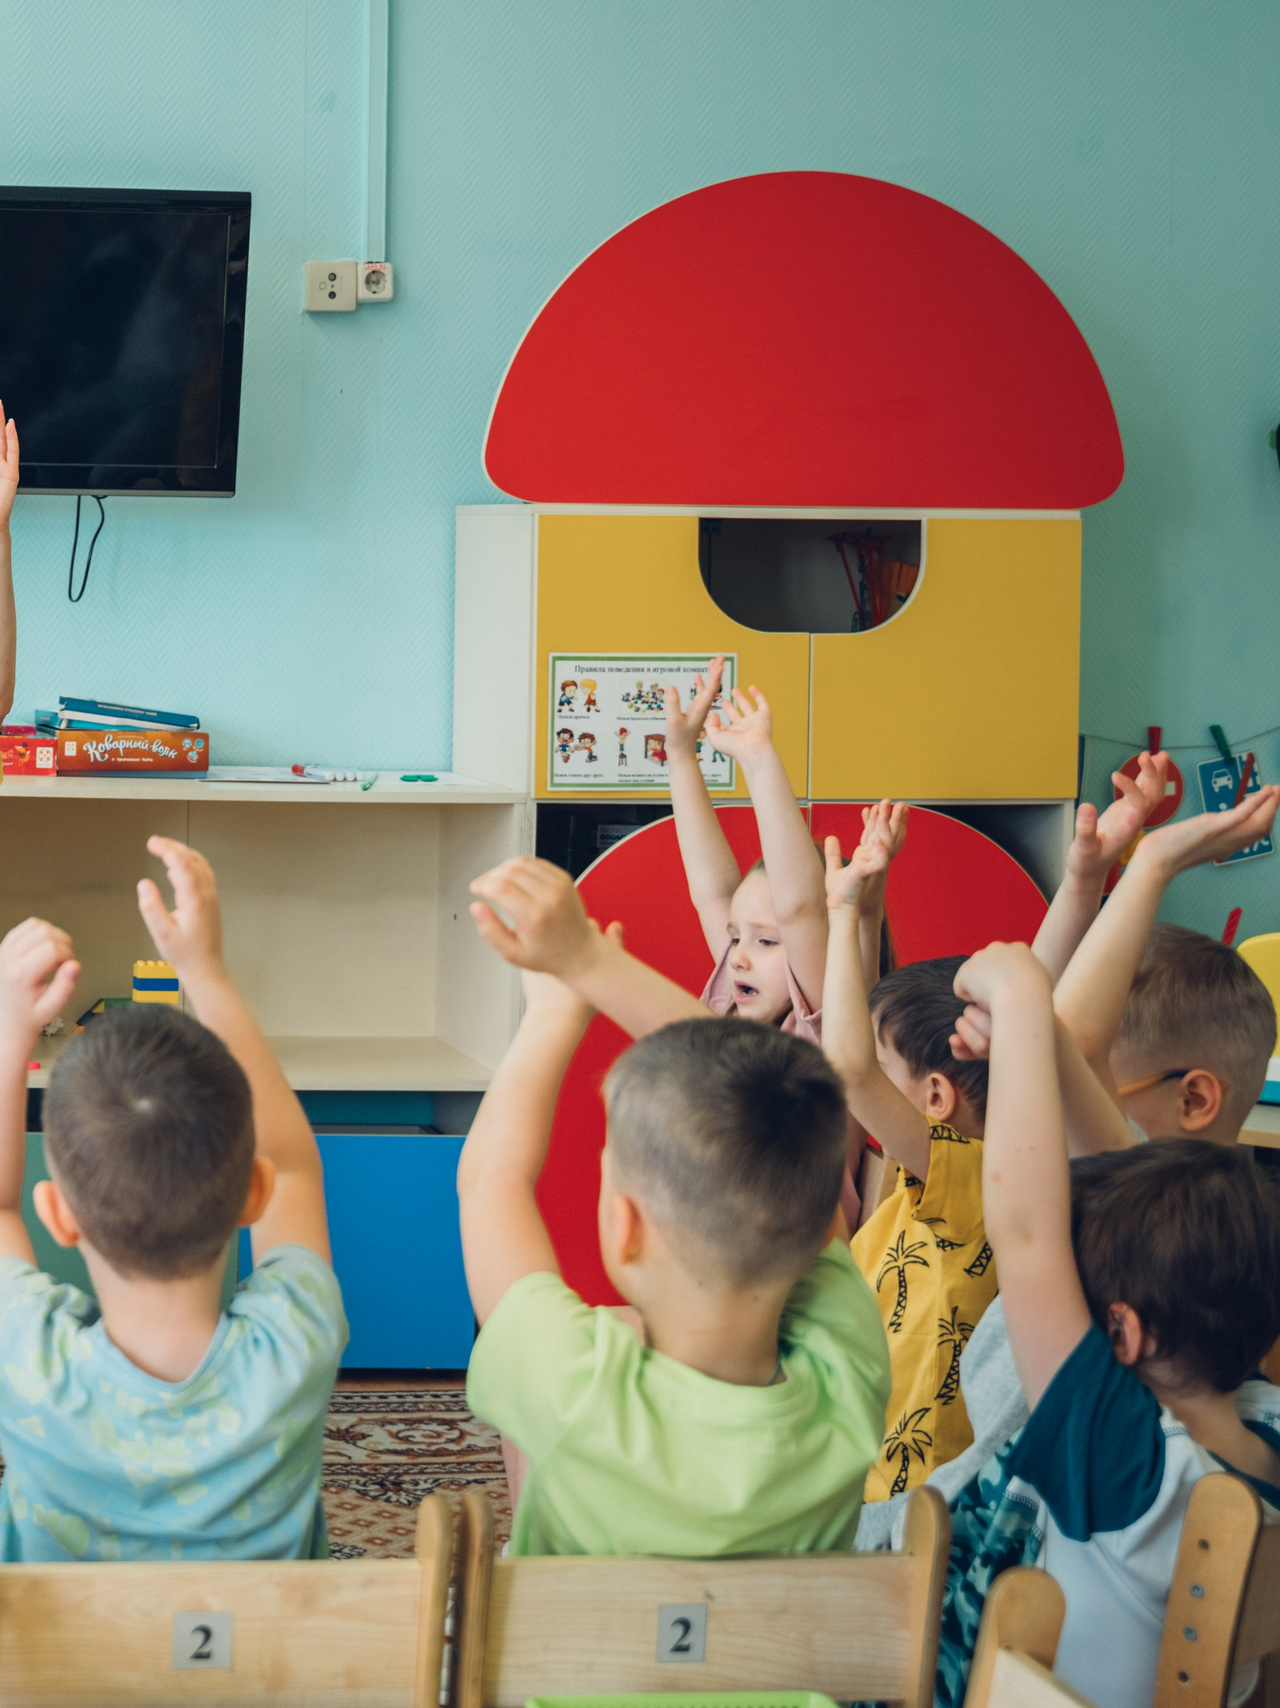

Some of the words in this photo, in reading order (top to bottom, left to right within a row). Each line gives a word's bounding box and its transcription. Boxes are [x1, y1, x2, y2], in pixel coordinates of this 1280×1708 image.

[574, 665, 606, 674] Правила
[607, 666, 645, 674] поведения
[652, 666, 681, 675] игровой
[82, 733, 149, 763] Коварный
[151, 739, 178, 759] волк
[189, 1624, 212, 1660] 2
[668, 1616, 691, 1653] 2
